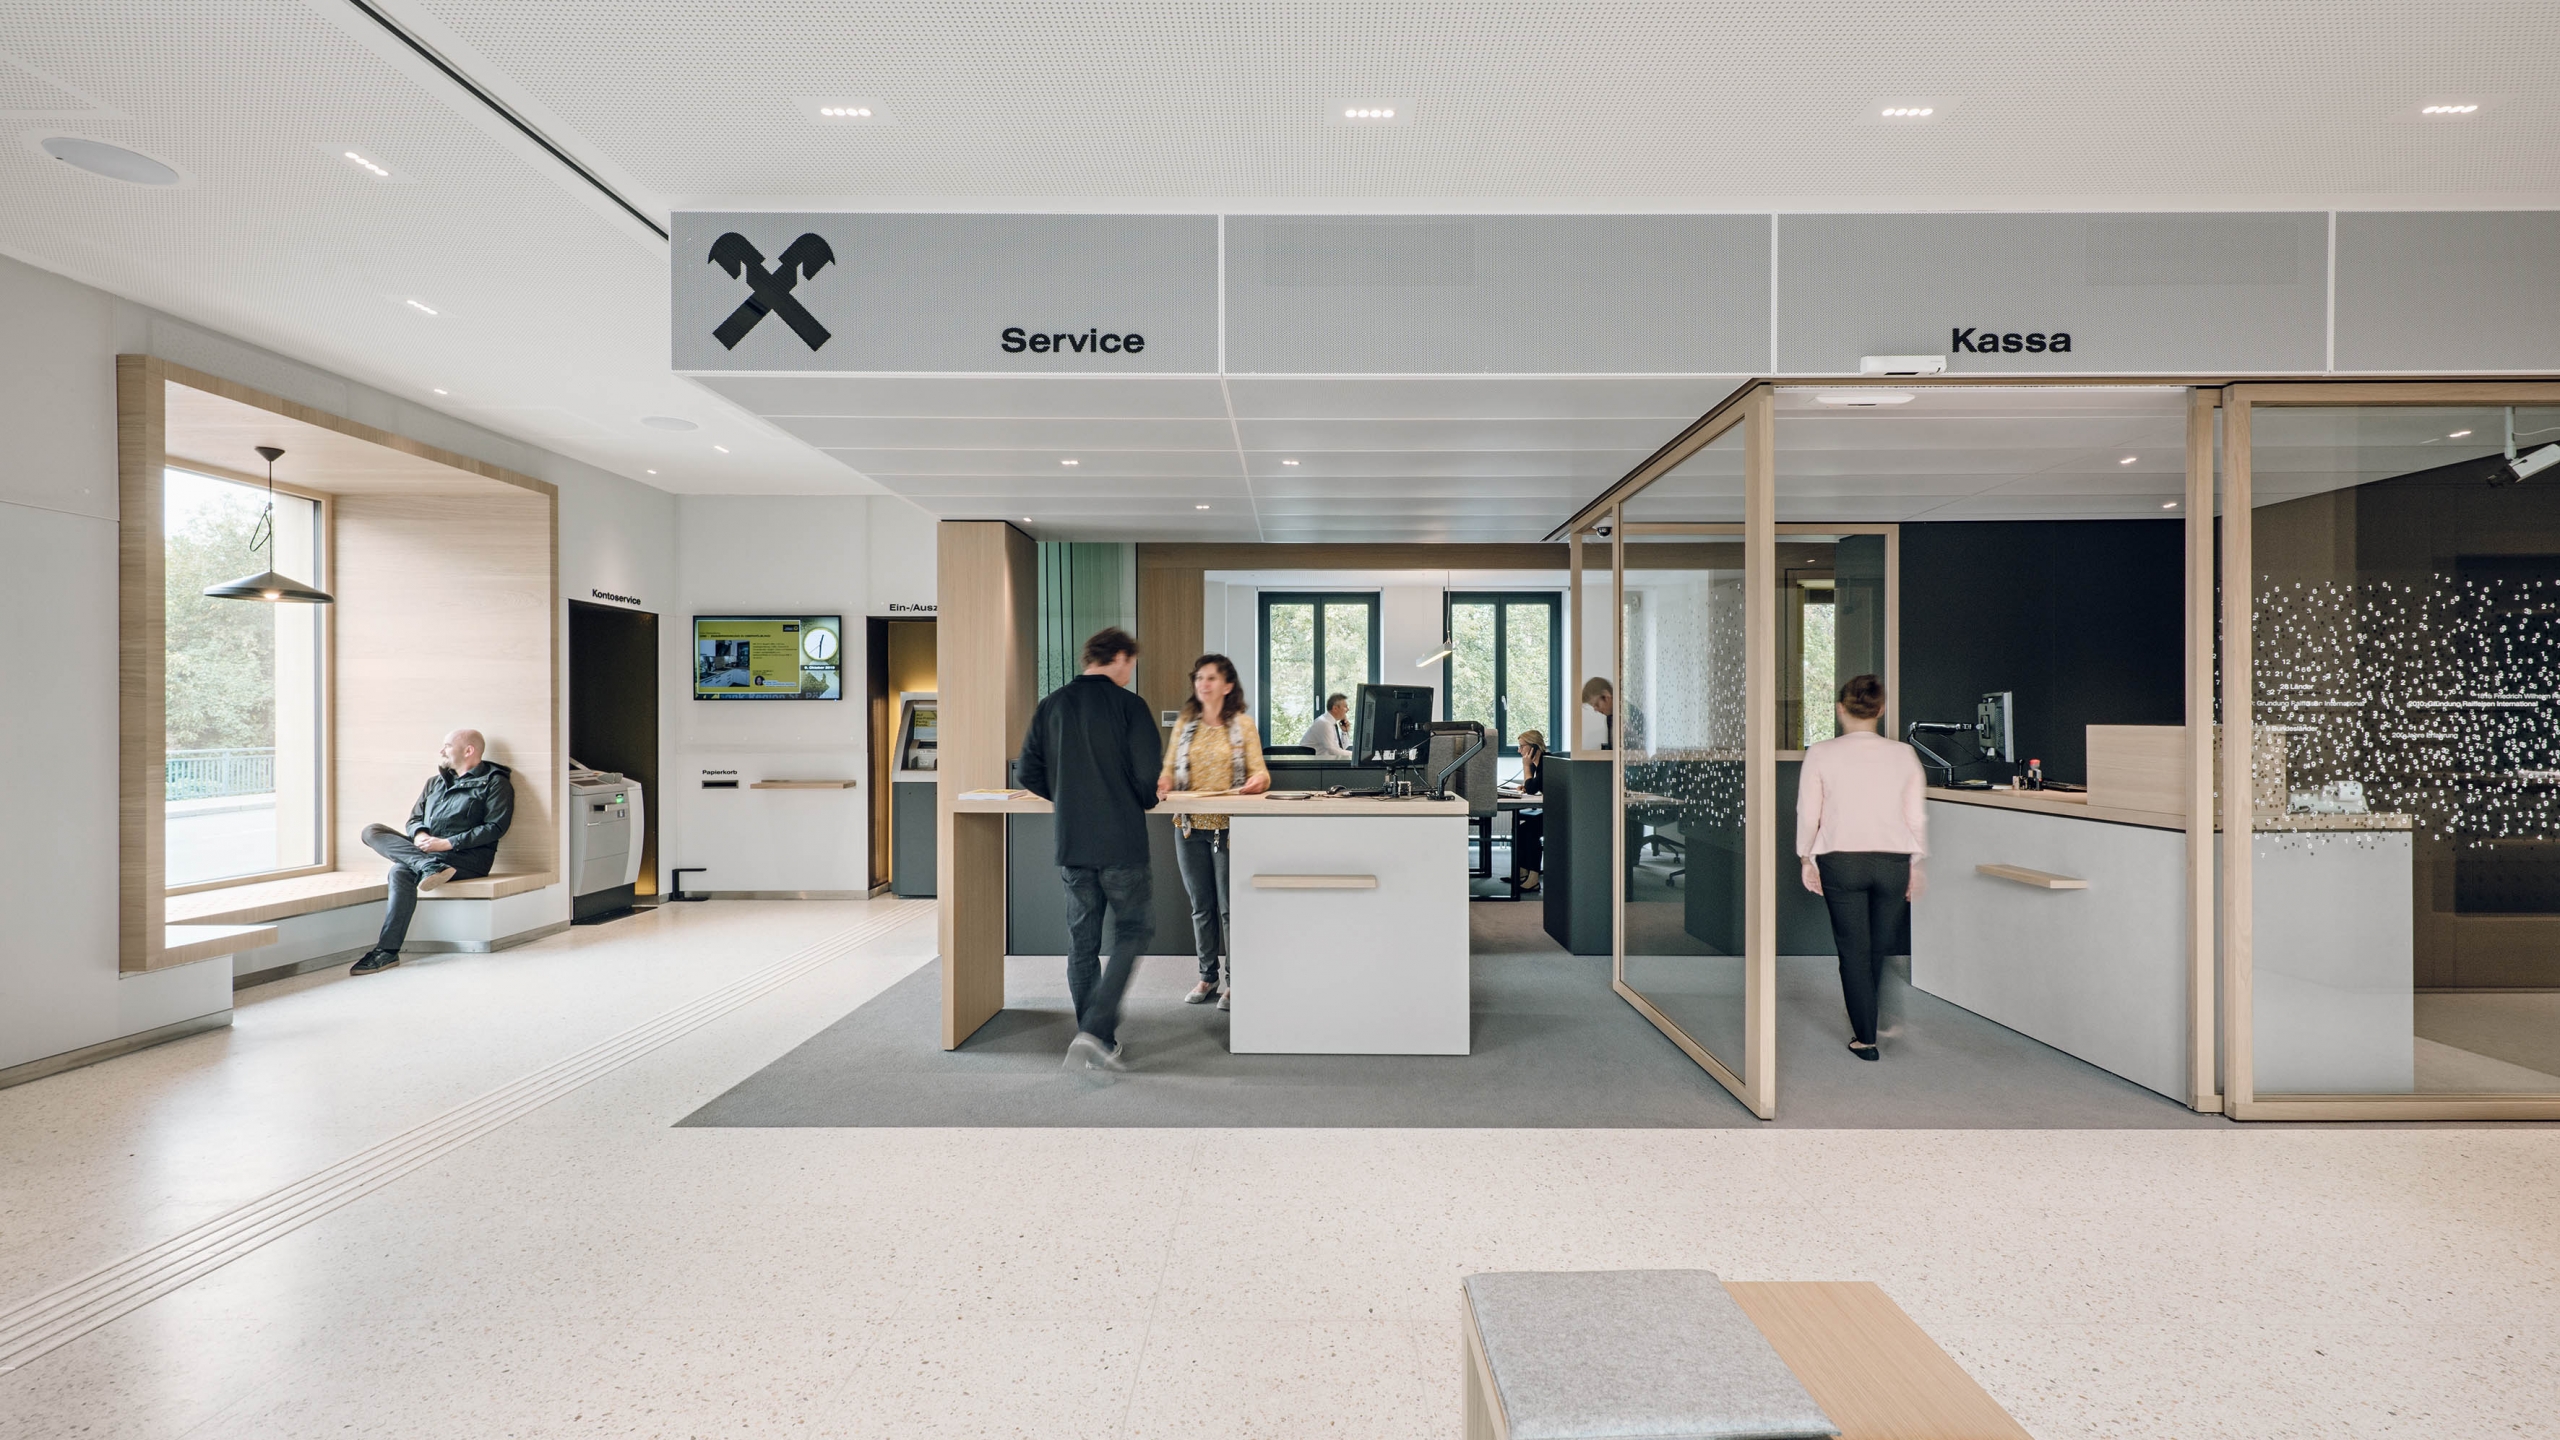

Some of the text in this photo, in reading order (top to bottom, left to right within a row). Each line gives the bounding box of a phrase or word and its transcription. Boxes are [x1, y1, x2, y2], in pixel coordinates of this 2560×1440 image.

[1001, 327, 1145, 353] Service
[1952, 328, 2072, 353] Kassa
[592, 588, 641, 605] Kontoservice
